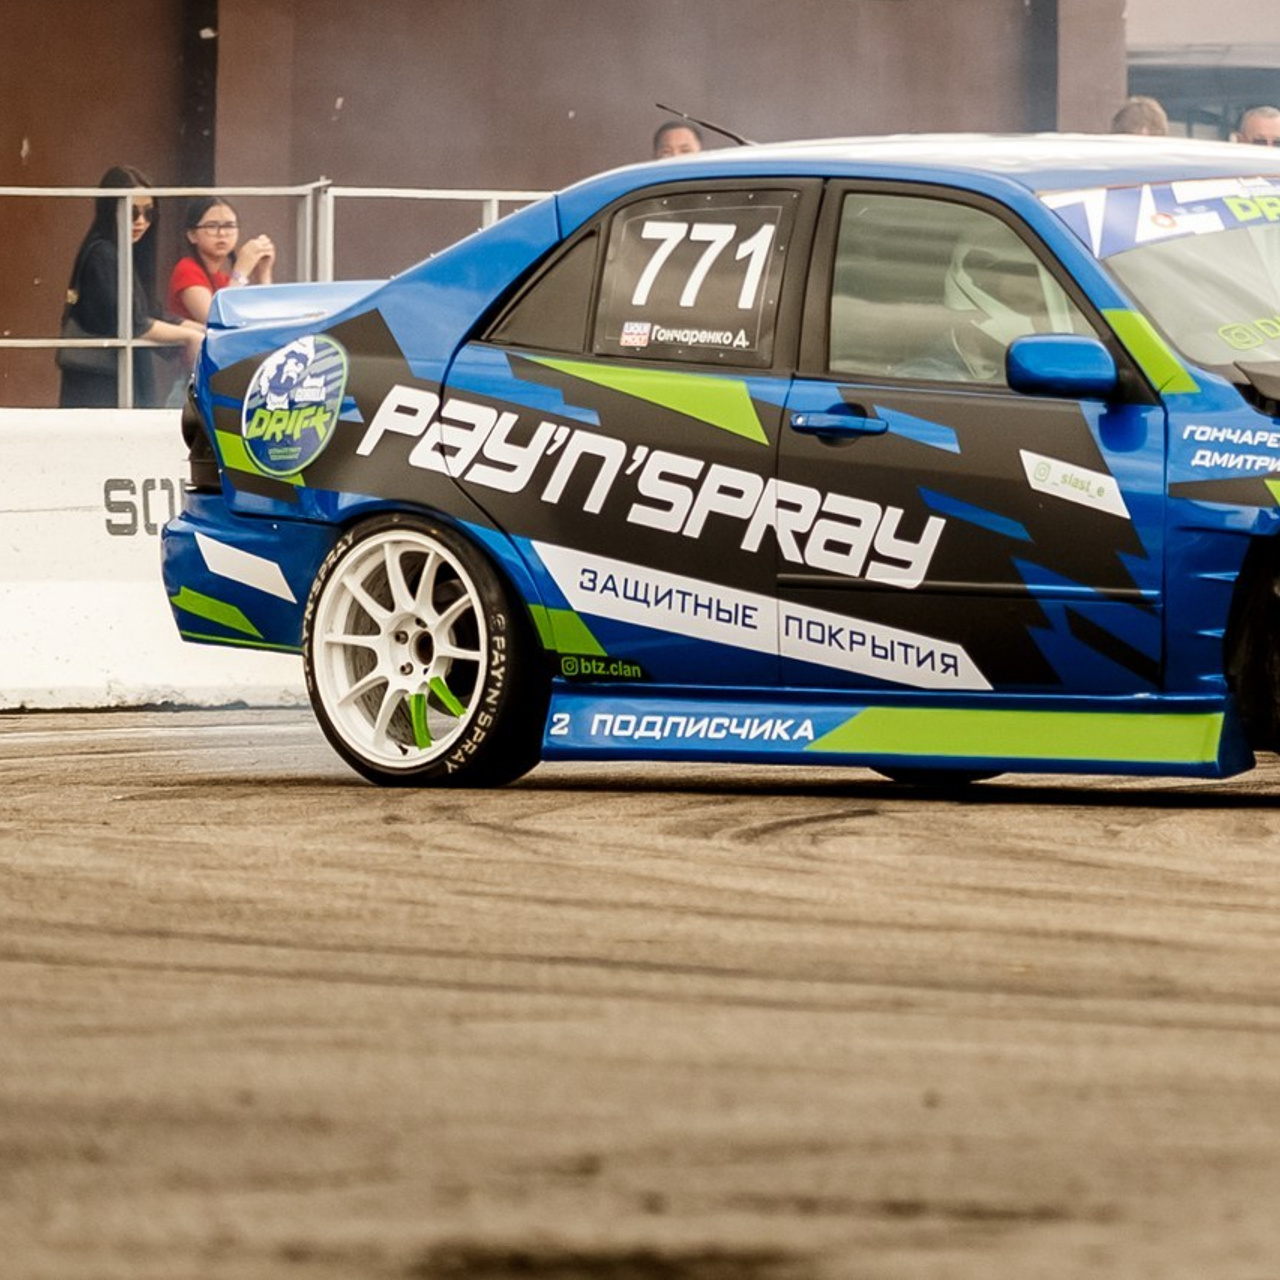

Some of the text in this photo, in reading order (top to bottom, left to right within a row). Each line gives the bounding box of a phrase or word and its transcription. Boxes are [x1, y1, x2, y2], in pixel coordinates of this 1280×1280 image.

[631, 220, 776, 310] 771
[651, 324, 734, 346] Гончаренко
[246, 405, 332, 443] DRIFT
[104, 478, 186, 536] SO
[578, 567, 960, 677] ЗАЩИТНЫЕ ПОКРЫТИЯ
[580, 658, 642, 678] btz.clan
[550, 713, 815, 741] 2 ПОДПИСЧИКА
